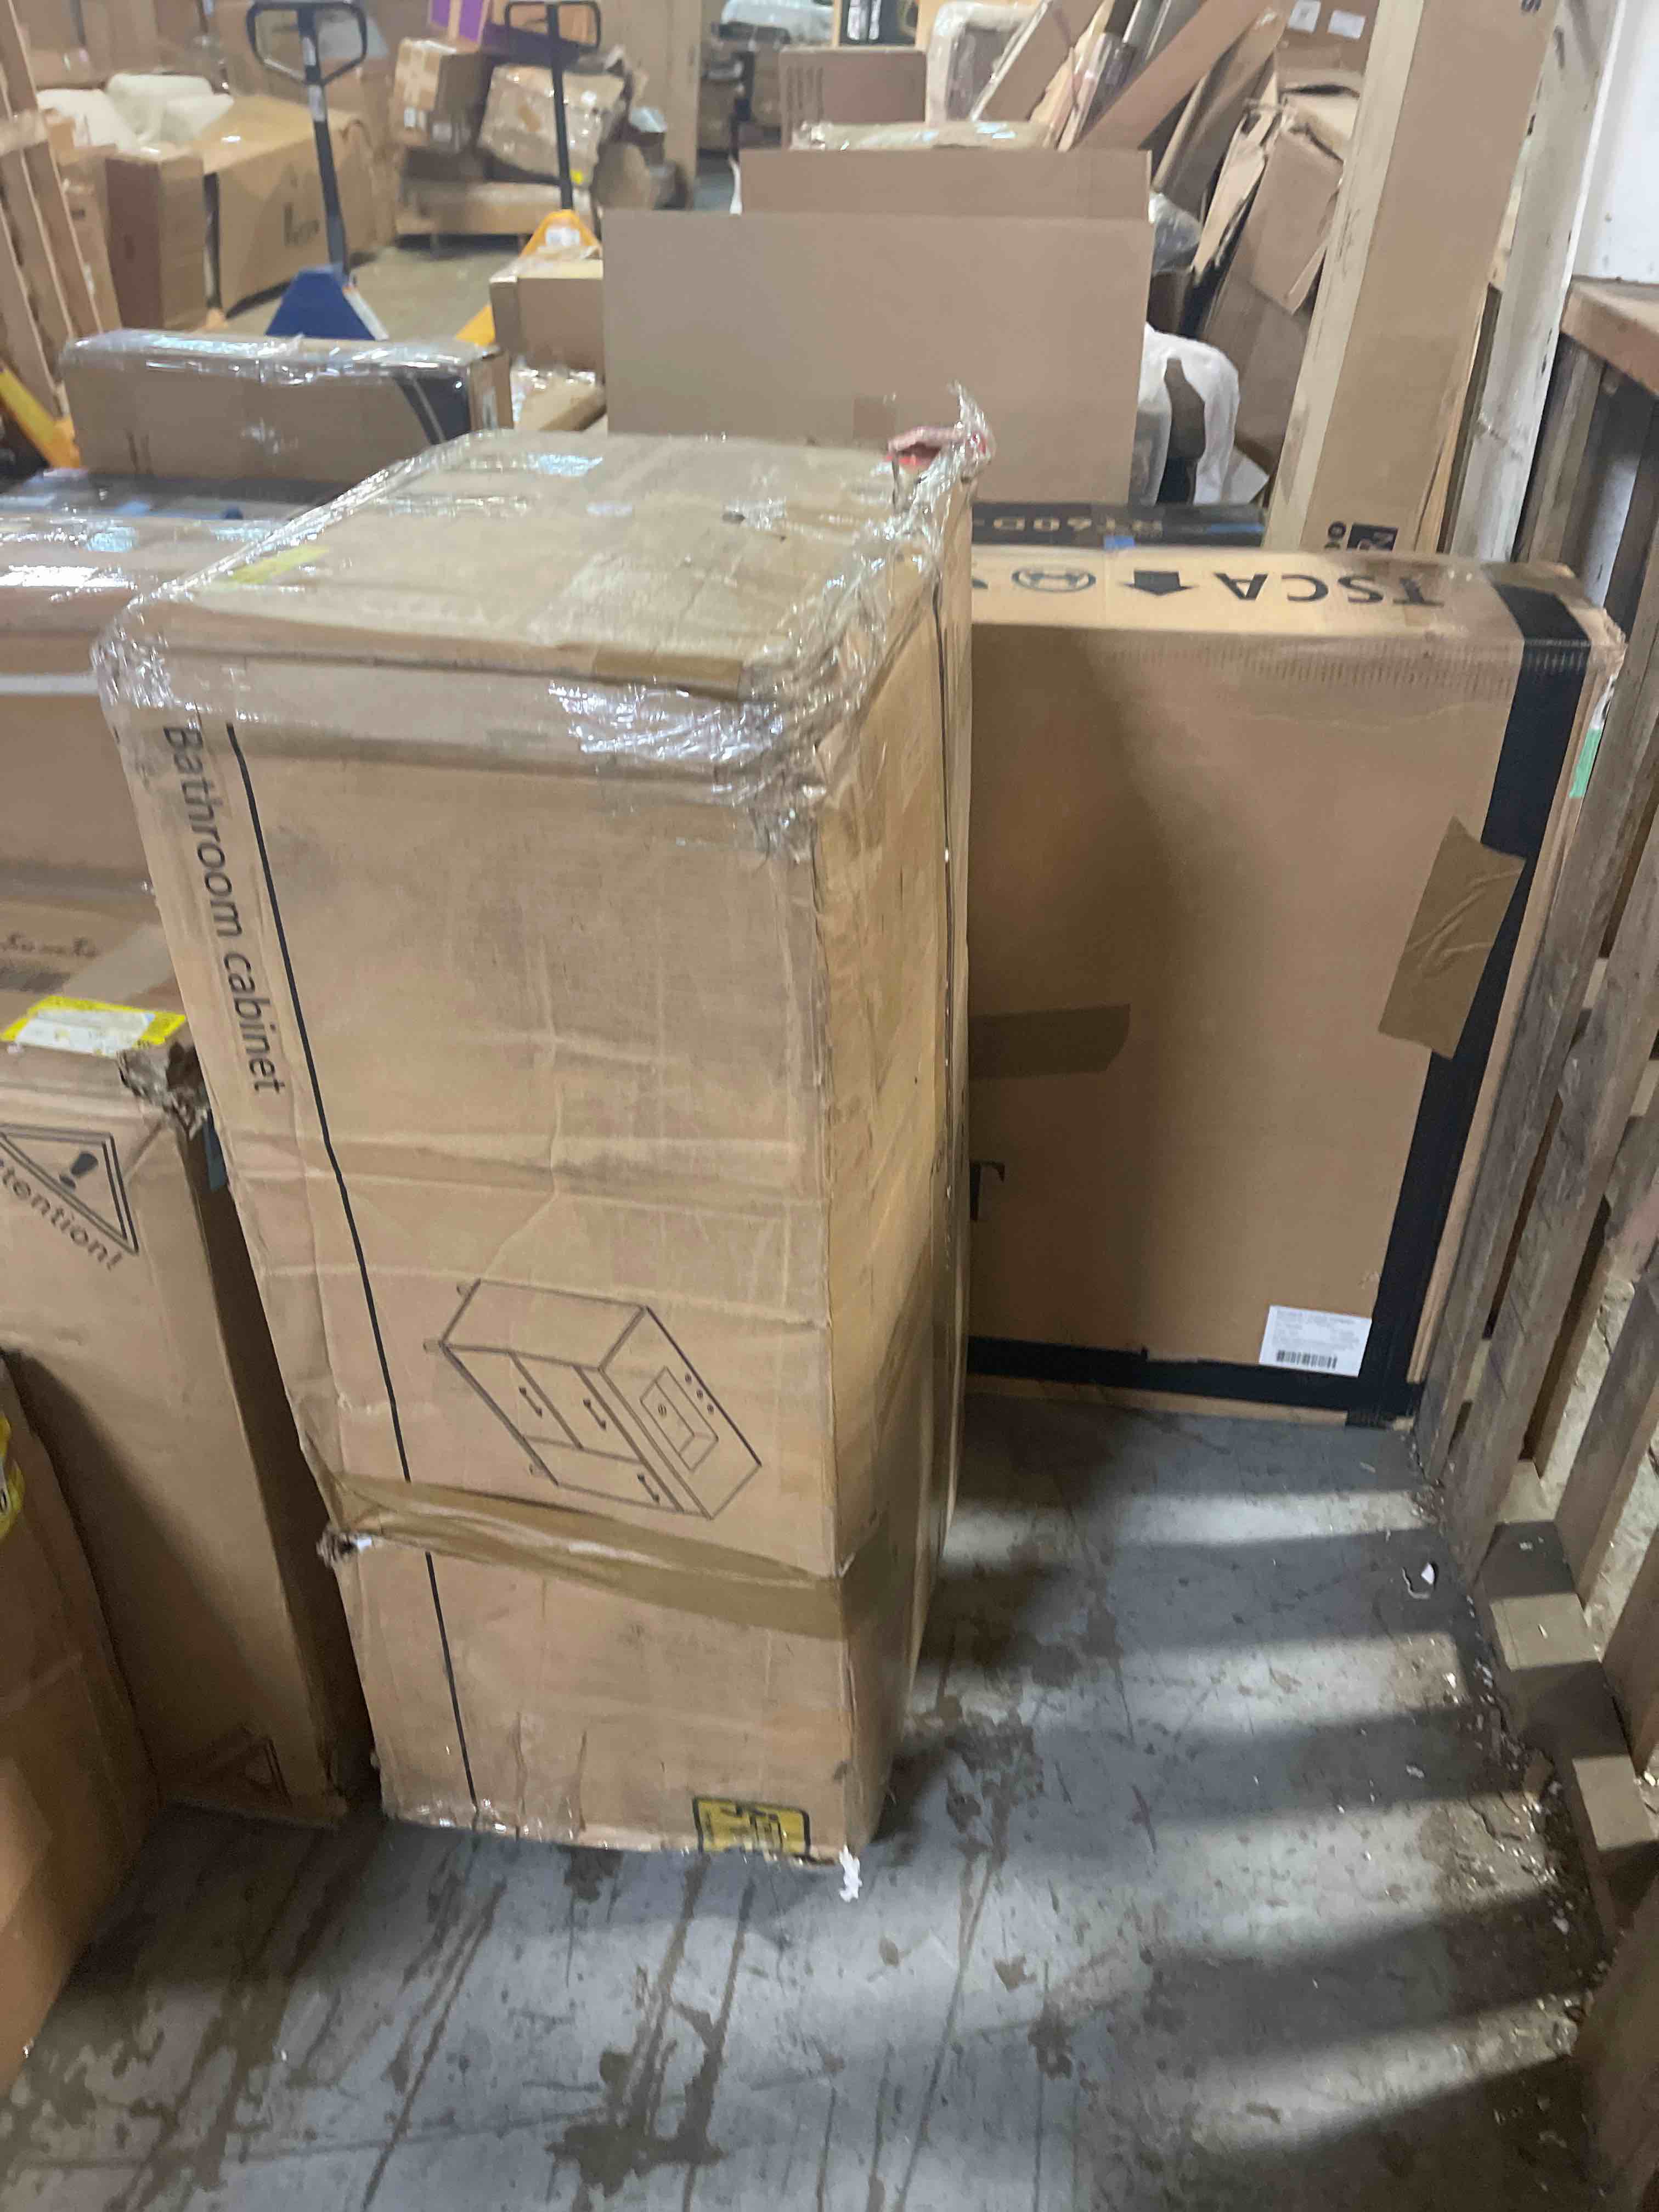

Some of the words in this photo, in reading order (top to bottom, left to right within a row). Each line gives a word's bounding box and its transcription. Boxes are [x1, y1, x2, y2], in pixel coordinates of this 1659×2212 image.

[1213, 573, 1444, 607] TSCA
[163, 726, 242, 936] Bathroom
[223, 953, 285, 1093] cabinet
[0, 1159, 122, 1271] tention!
